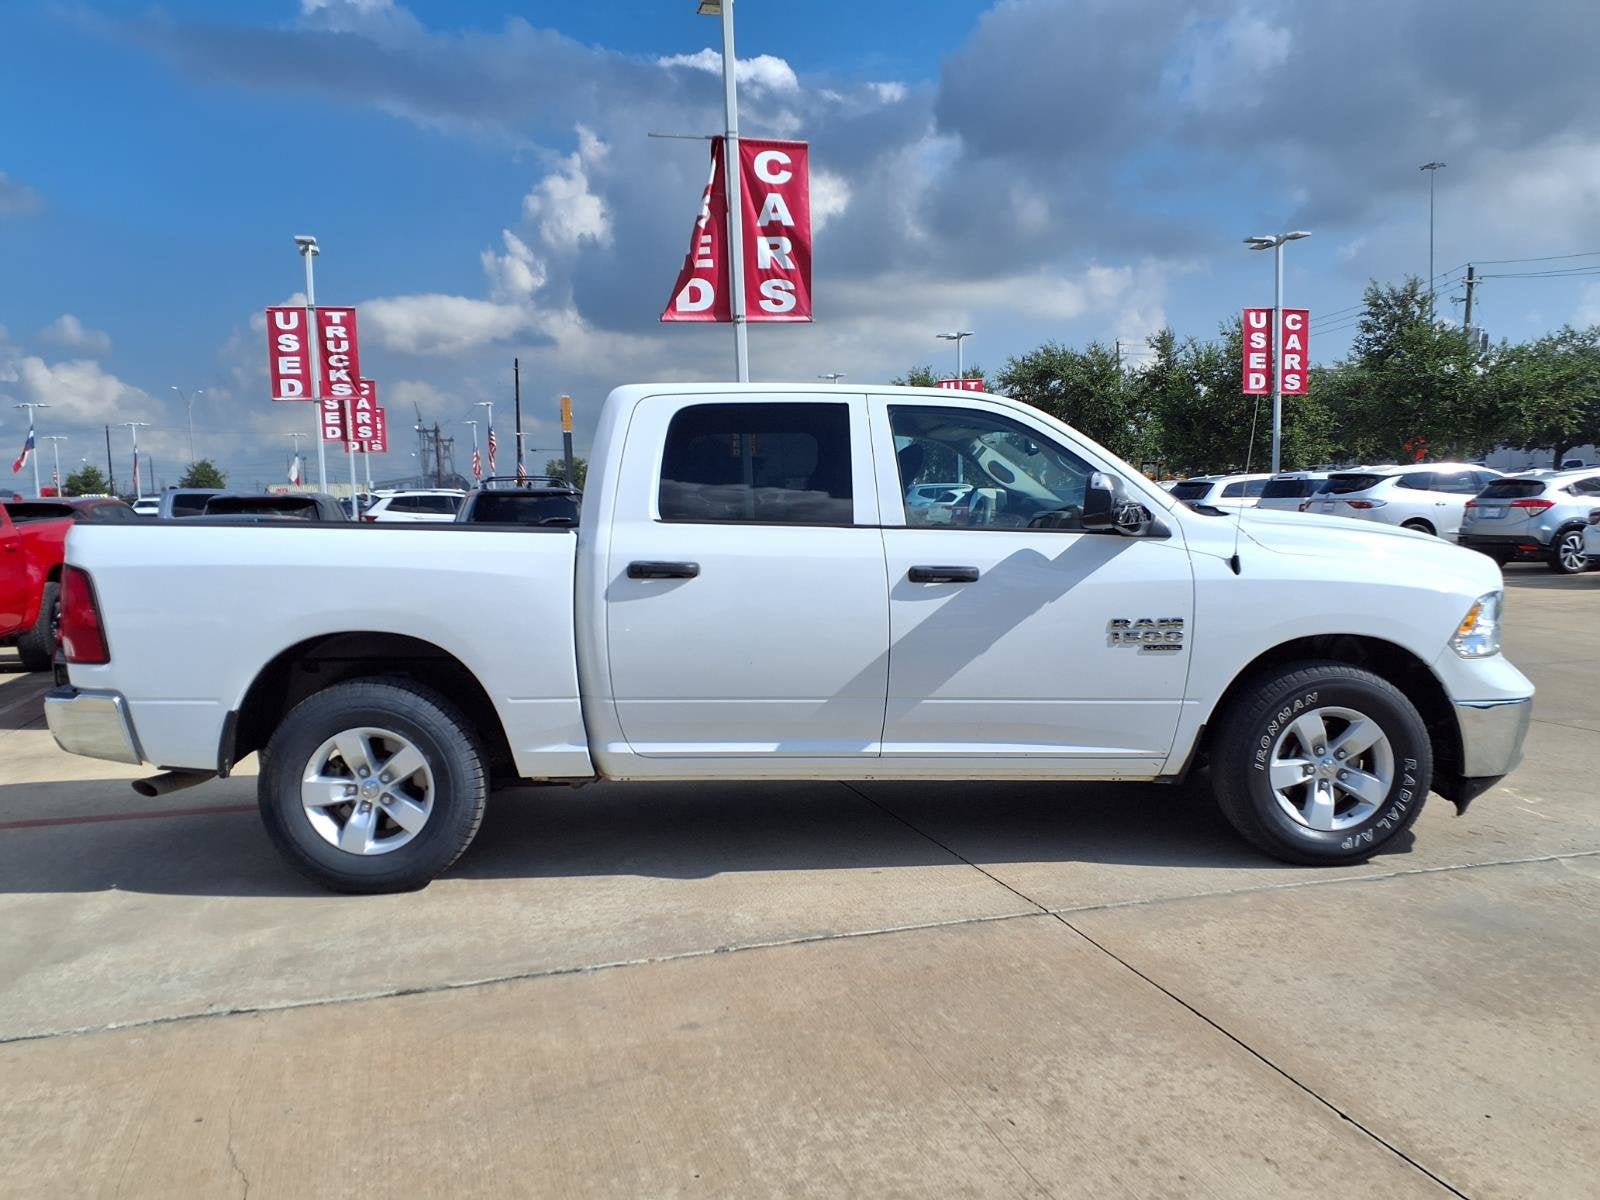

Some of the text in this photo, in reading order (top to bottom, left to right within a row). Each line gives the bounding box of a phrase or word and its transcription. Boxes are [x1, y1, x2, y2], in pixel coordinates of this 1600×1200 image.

[752, 149, 797, 313] CARS
[274, 311, 303, 397] USED
[324, 311, 352, 396] TRUCKS
[1249, 311, 1267, 390] USED
[1283, 313, 1302, 390] CARS
[324, 399, 342, 439] SED
[1110, 617, 1183, 630] RAM
[1110, 630, 1183, 644] 1500
[1254, 691, 1319, 771] IRONMAN
[1376, 757, 1417, 830] RADIAL
